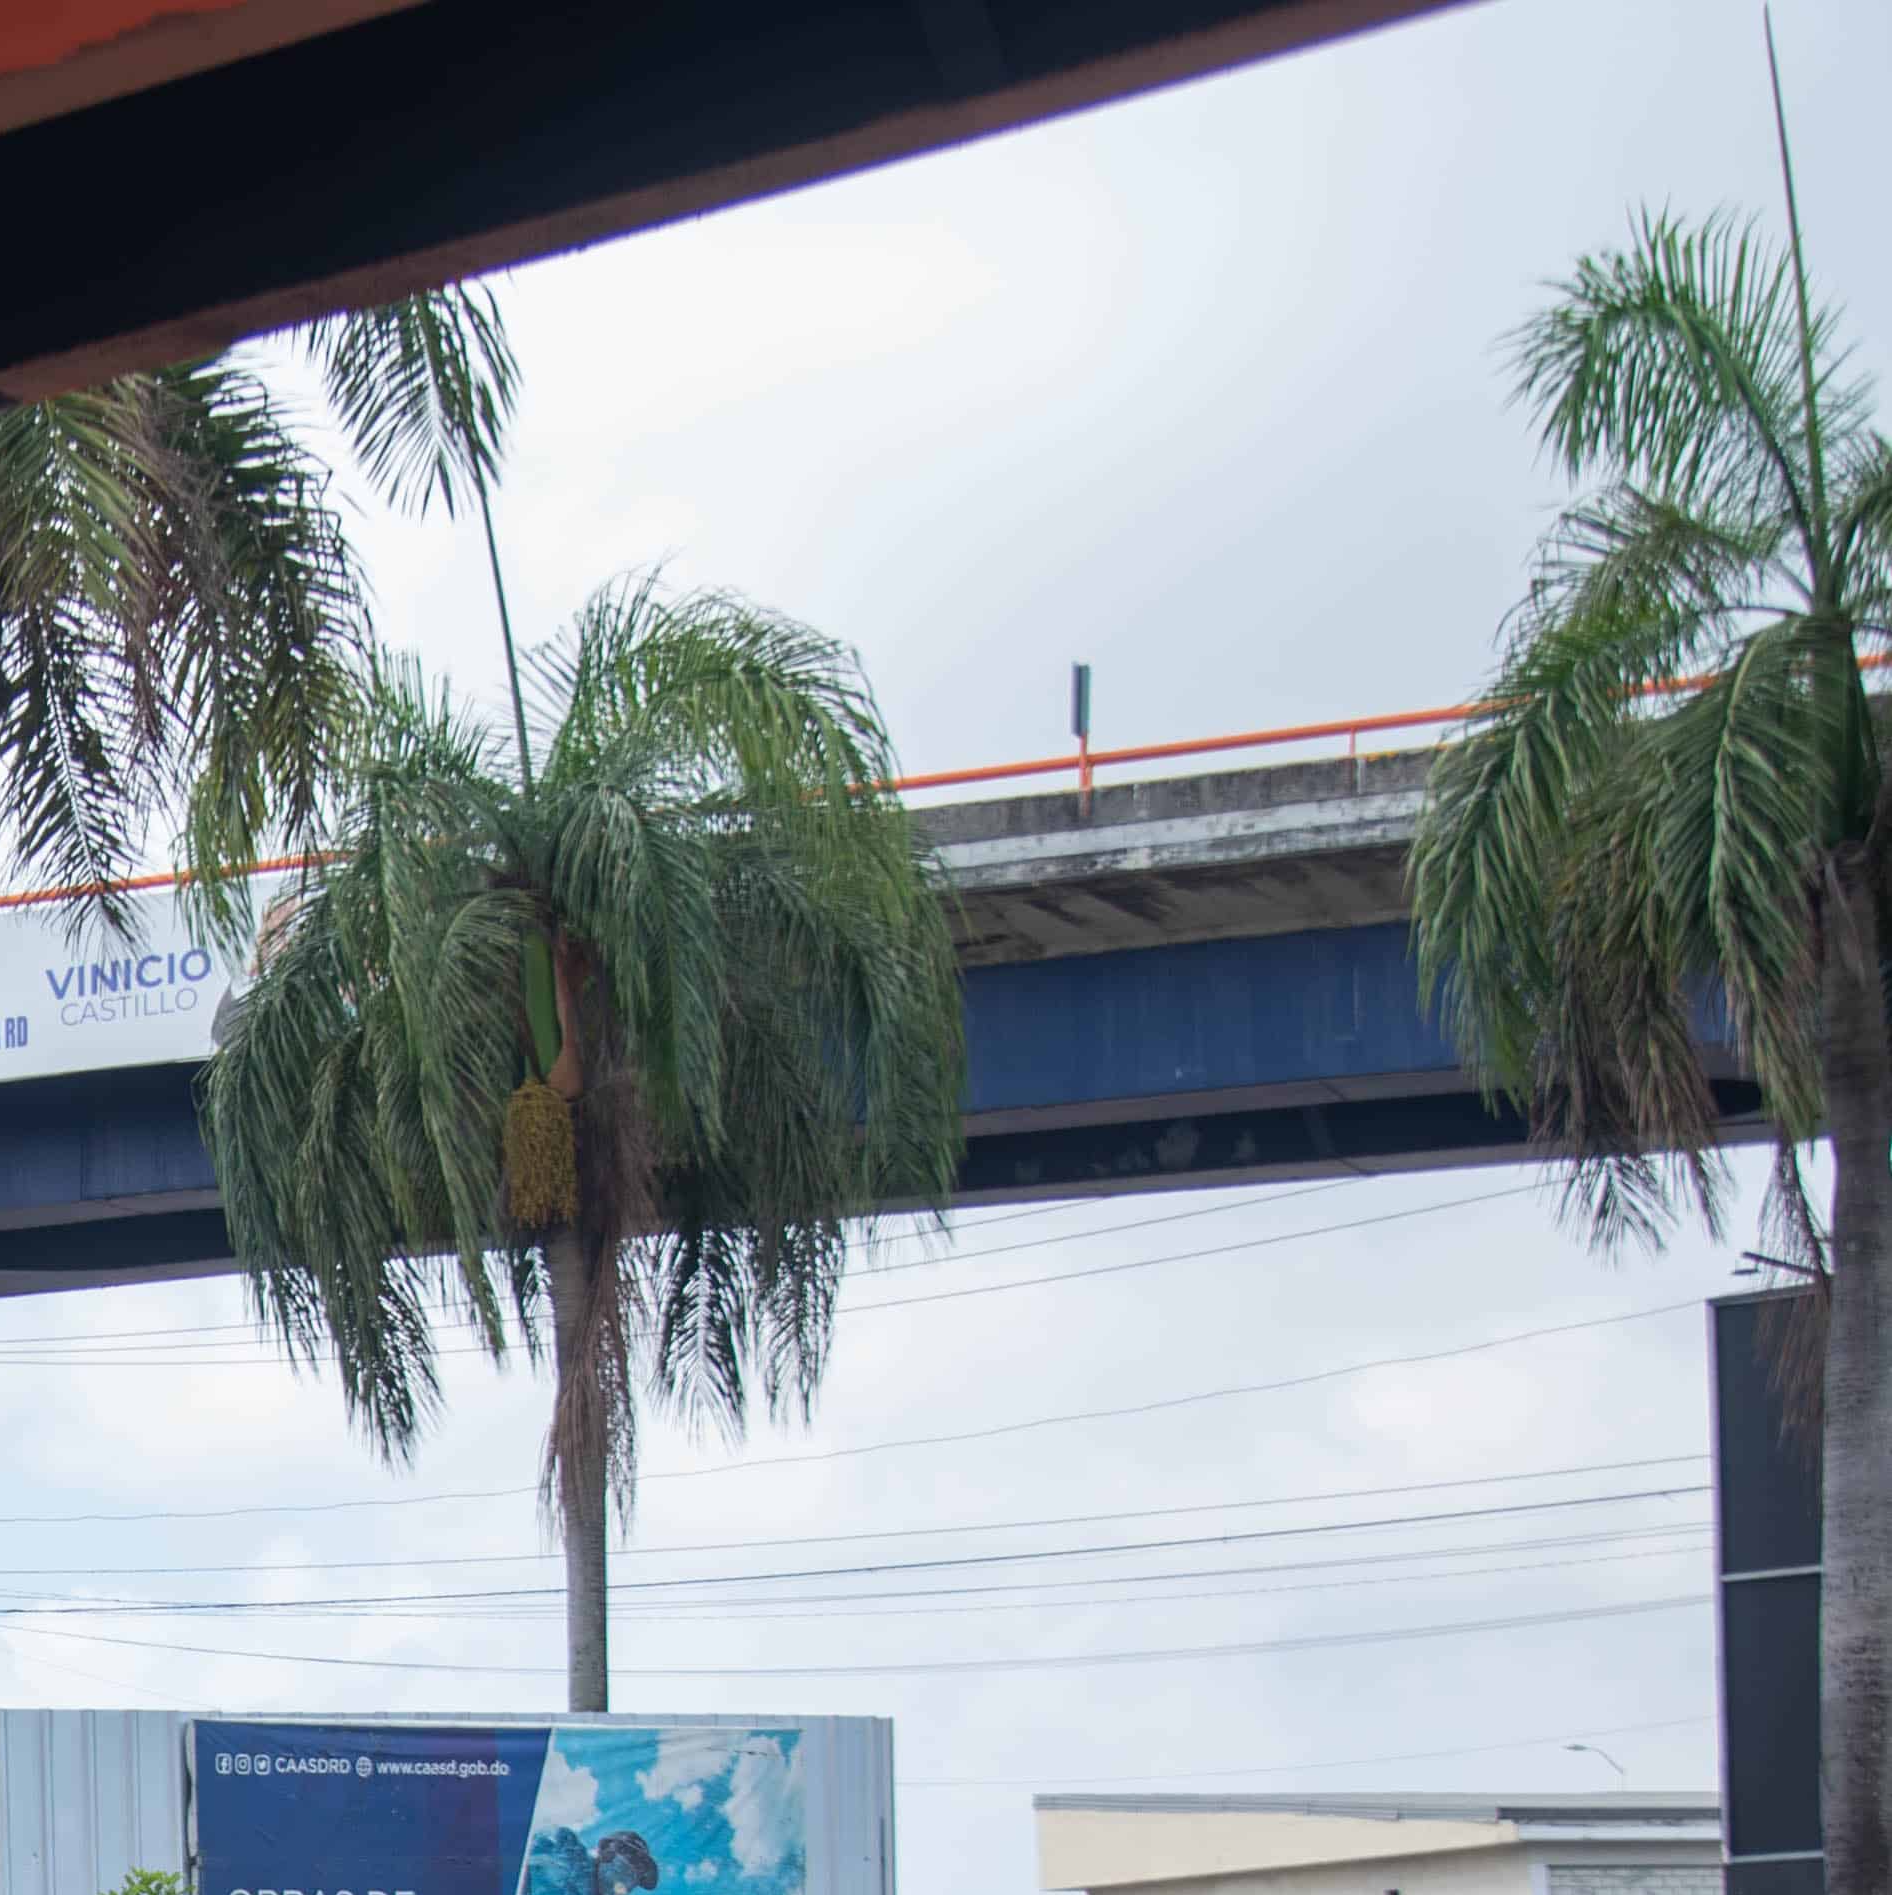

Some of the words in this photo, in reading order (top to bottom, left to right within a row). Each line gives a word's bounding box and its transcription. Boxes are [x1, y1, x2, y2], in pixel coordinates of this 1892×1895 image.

[45, 949, 212, 1000] VINICIO
[60, 987, 199, 1026] CASTILLO
[5, 1016, 28, 1048] RD
[275, 1757, 351, 1774] CAASDRD
[376, 1759, 510, 1778] www.caasd.gob.do
